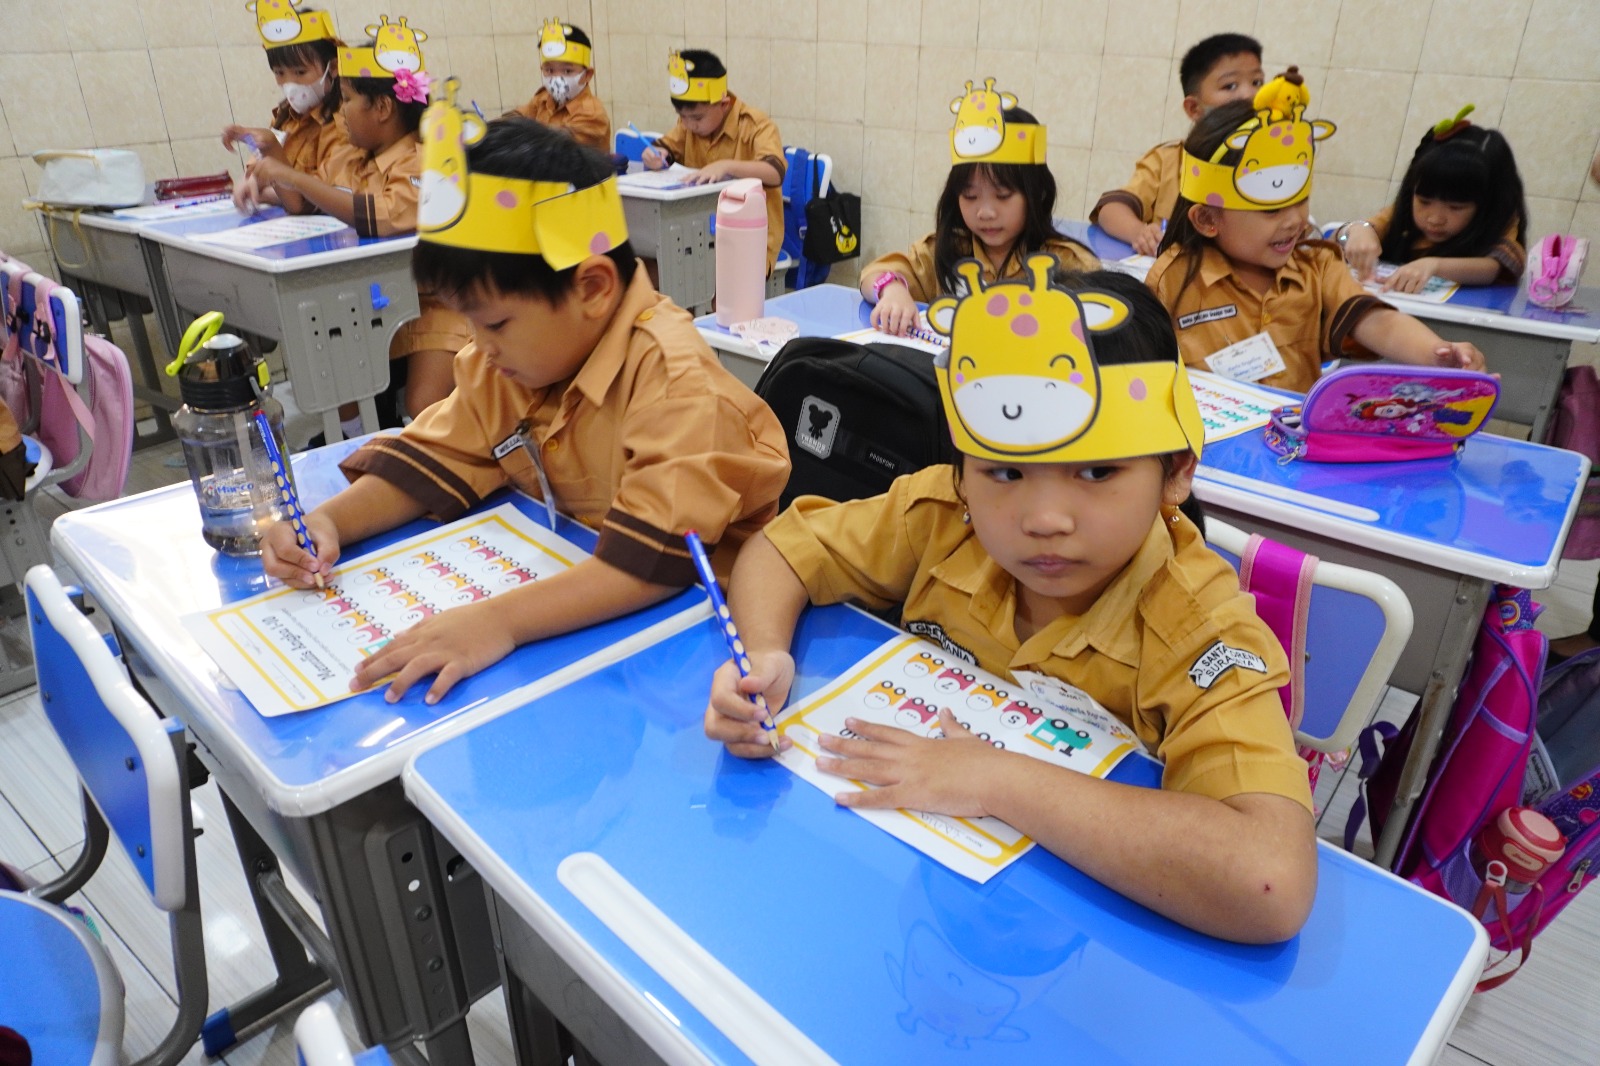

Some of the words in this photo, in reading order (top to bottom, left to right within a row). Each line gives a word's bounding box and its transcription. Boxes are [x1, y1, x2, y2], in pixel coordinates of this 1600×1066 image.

[1201, 645, 1228, 667] SANTA
[940, 681, 955, 690] 7
[1007, 714, 1021, 726] 5
